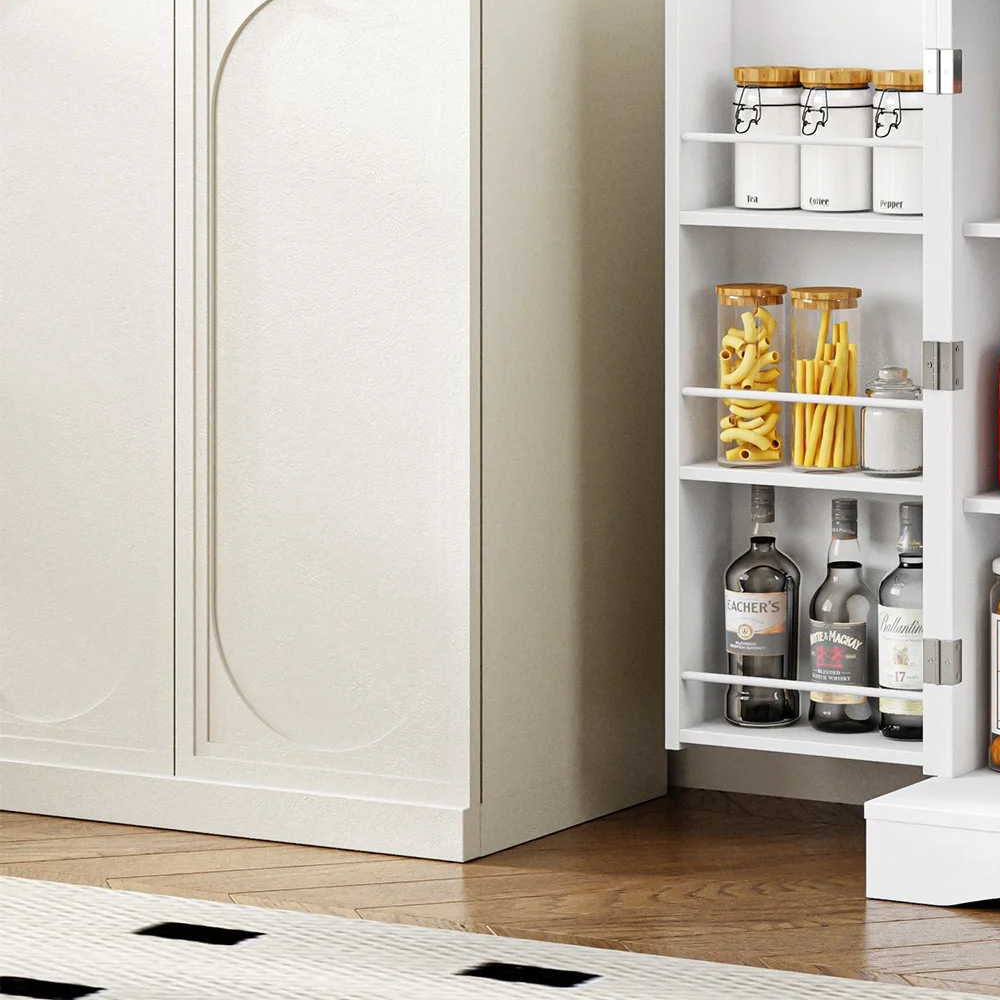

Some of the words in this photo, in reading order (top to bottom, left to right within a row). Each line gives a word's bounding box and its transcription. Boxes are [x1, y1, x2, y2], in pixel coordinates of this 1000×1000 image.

[746, 195, 758, 204] Tea
[880, 200, 903, 209] Pepper
[727, 599, 780, 614] EACHER'S
[829, 630, 863, 651] MACKAY
[895, 671, 906, 683] 17
